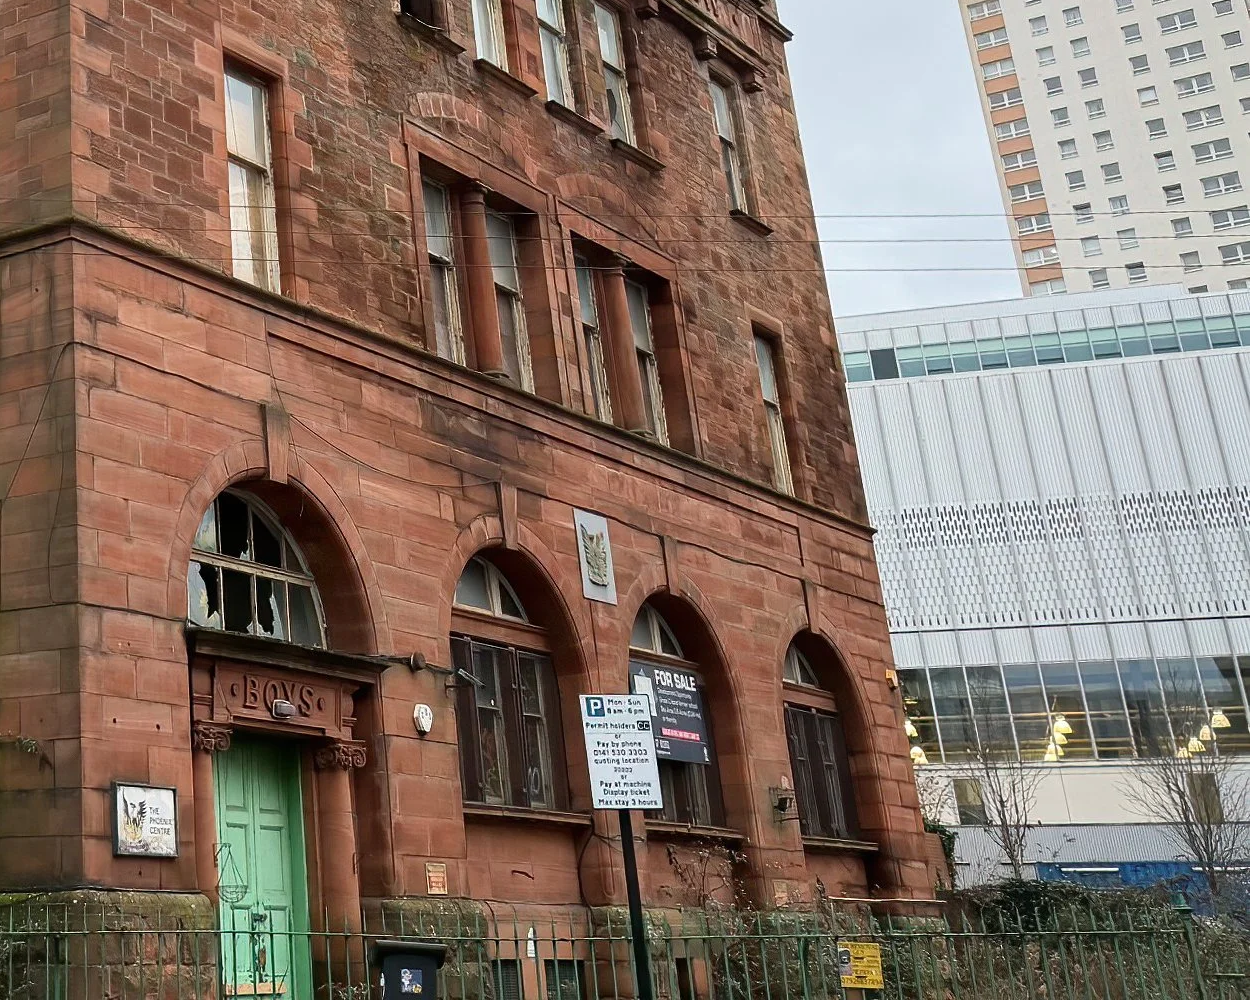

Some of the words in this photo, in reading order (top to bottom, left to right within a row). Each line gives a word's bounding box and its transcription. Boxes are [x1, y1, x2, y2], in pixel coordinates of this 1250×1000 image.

[654, 669, 674, 688] FOR
[673, 673, 697, 692] SALE
[243, 674, 314, 718] BOYS
[637, 722, 650, 730] CC
[149, 806, 159, 815] THE
[149, 827, 171, 835] CENTRE
